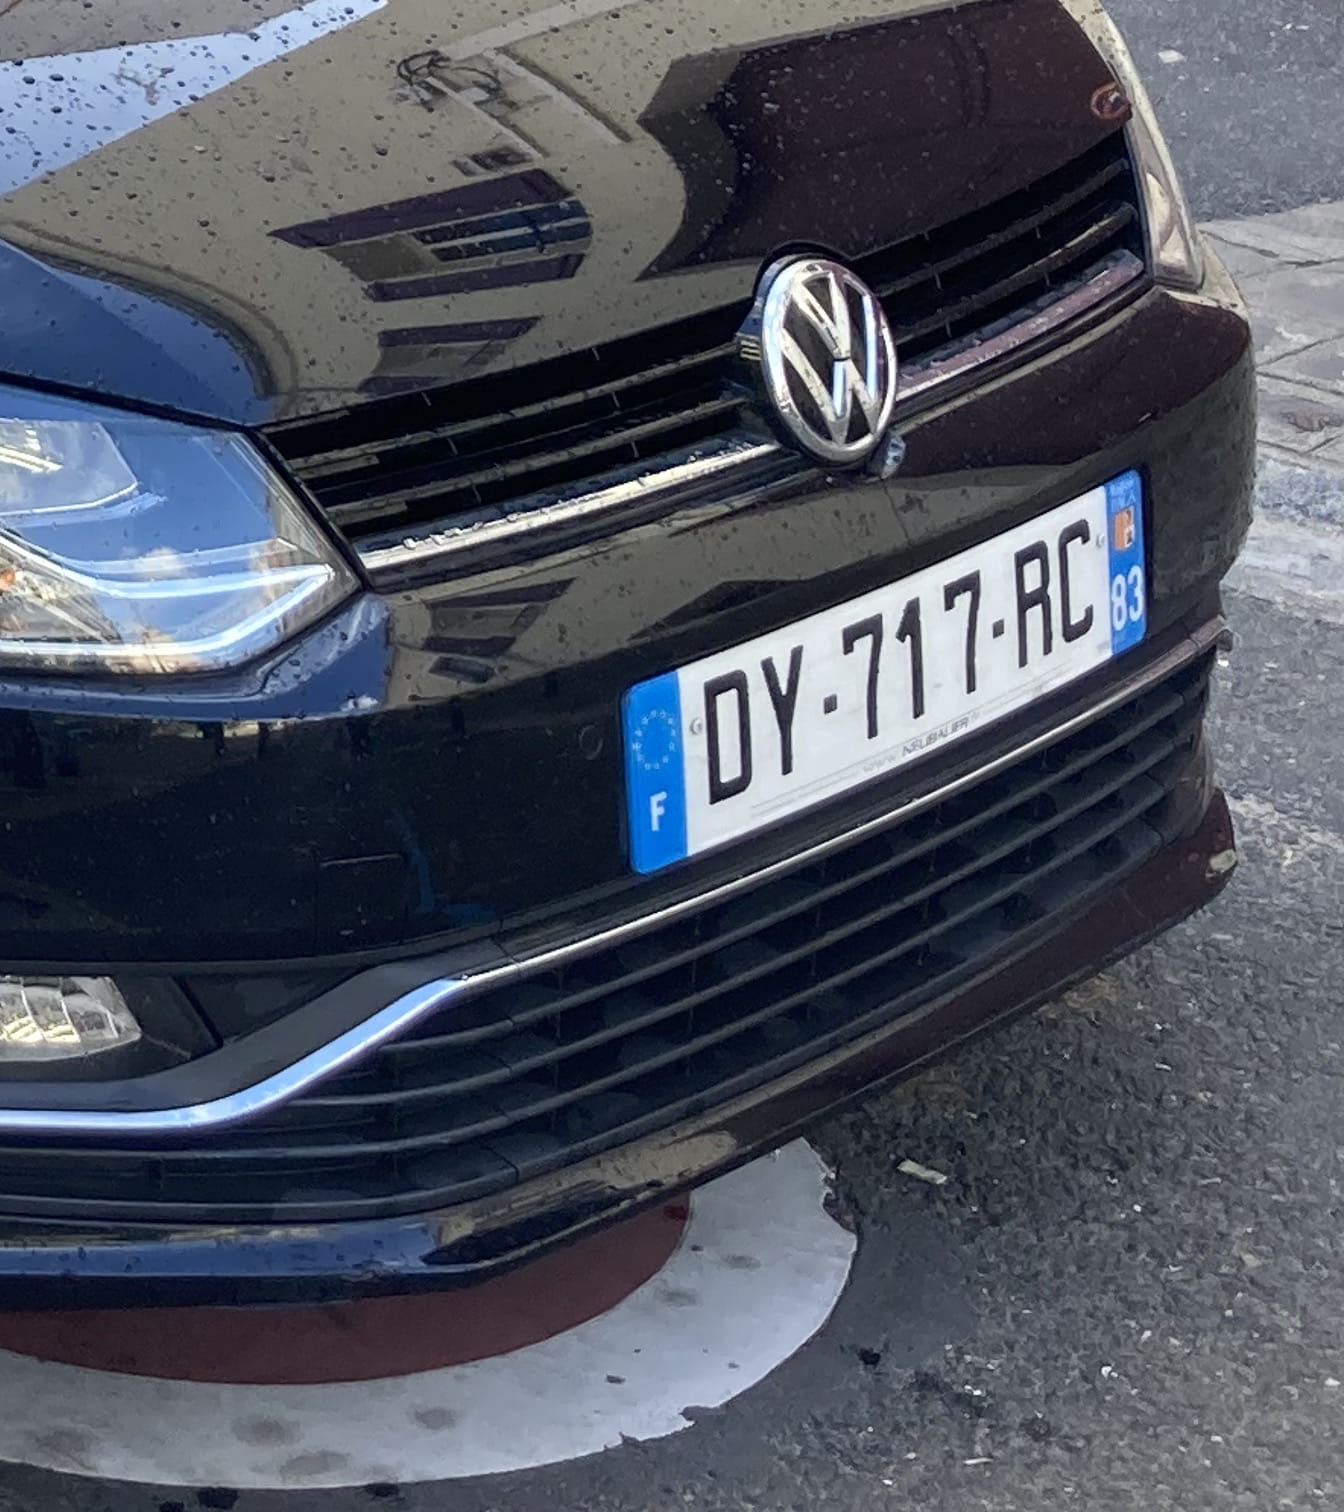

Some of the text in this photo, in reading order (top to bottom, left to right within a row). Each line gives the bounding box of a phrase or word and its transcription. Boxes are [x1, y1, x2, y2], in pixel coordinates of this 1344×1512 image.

[1111, 564, 1144, 632] 83
[703, 518, 1095, 806] DY-717-RC
[649, 790, 668, 832] F
